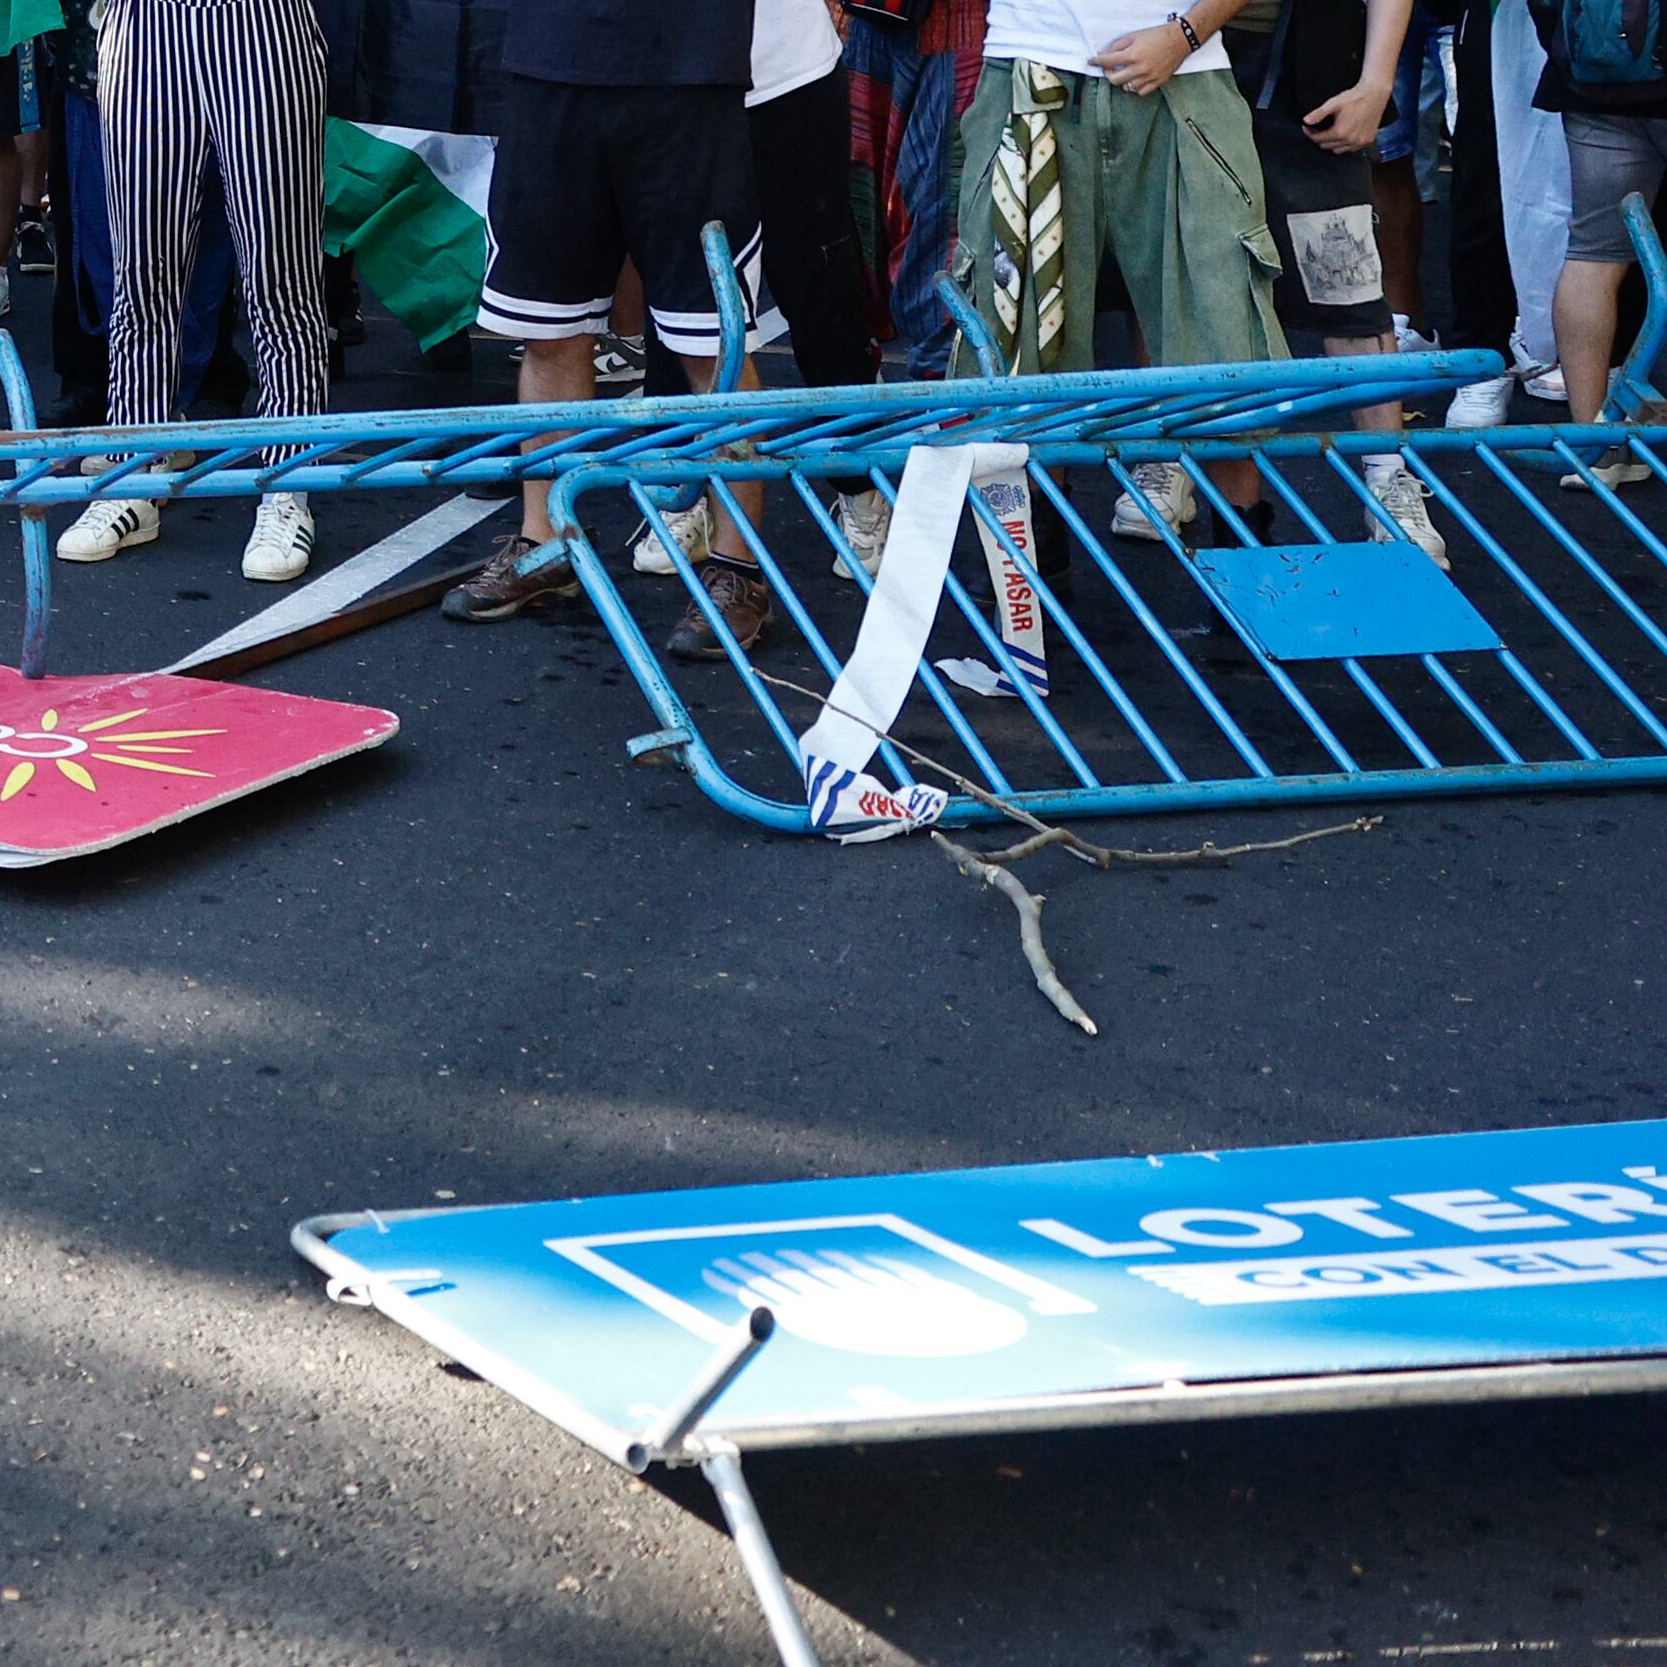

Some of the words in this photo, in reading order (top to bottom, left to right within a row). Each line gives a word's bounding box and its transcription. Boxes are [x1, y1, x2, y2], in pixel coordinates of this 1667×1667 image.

[1002, 558, 1034, 632] ASAR
[1236, 1258, 1469, 1288] CON
[1474, 1251, 1603, 1275] EL
